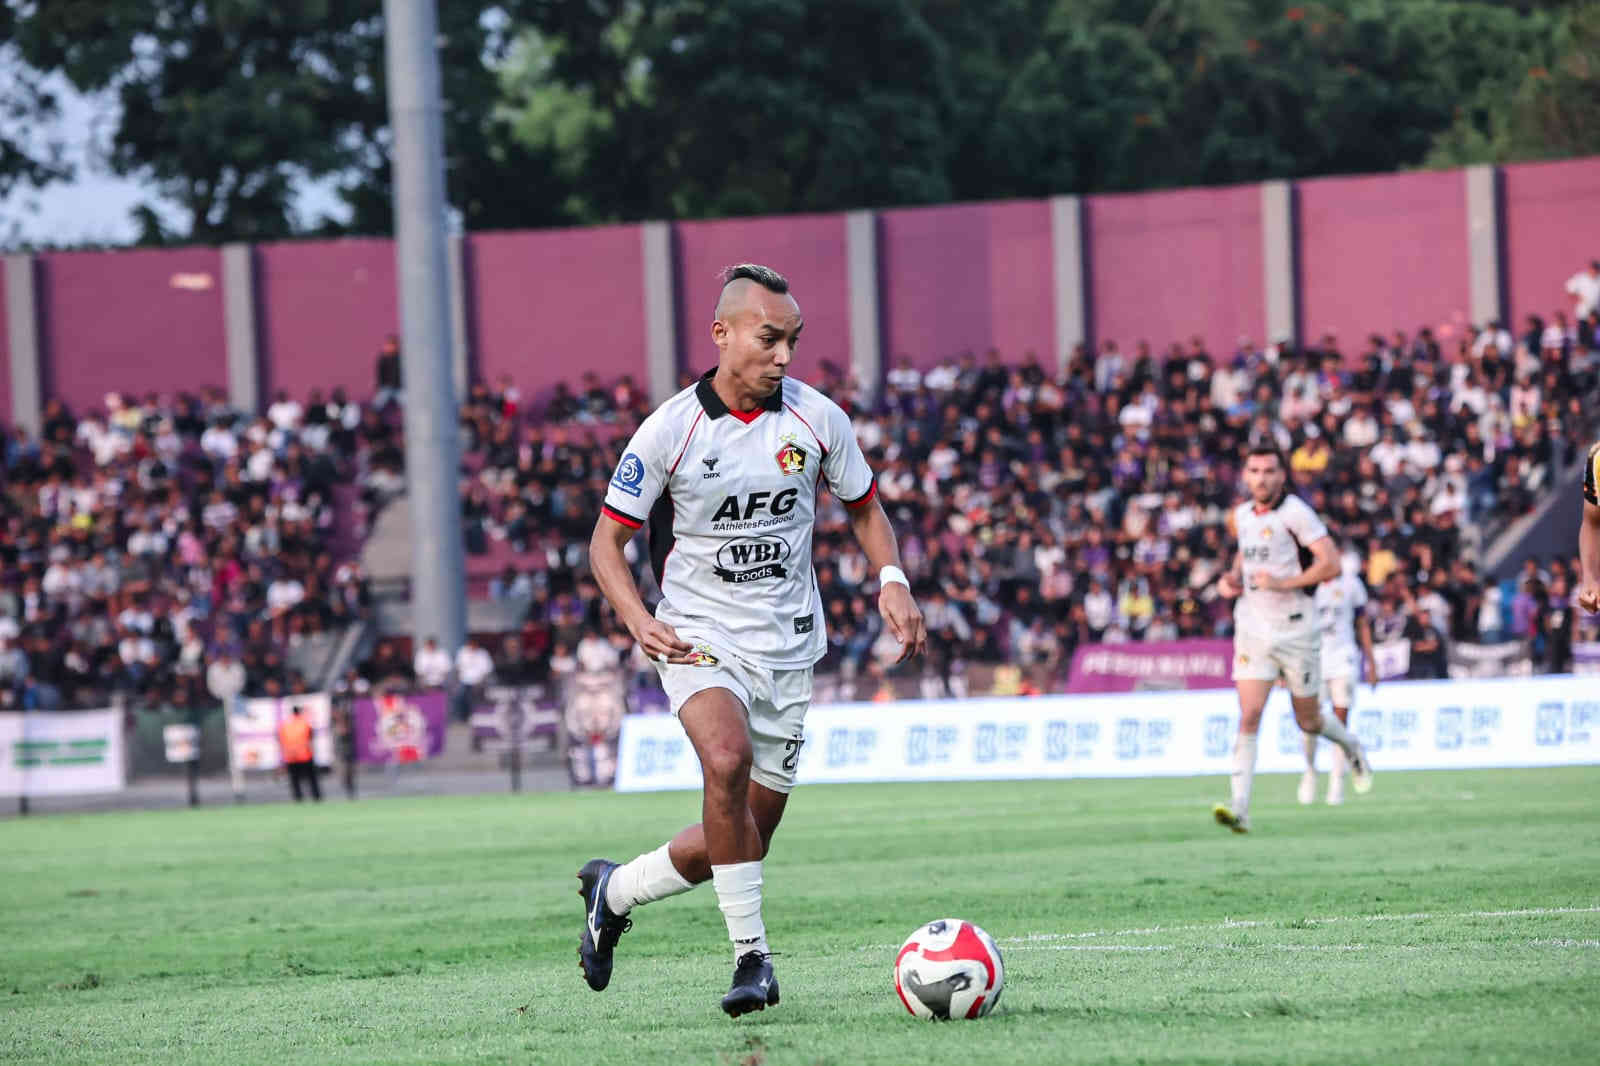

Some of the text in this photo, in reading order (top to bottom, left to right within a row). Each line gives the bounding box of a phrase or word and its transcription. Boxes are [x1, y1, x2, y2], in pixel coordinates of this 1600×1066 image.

[711, 488, 798, 521] AFG
[713, 513, 795, 531] #AthletesForGood
[729, 542, 781, 564] WBI
[734, 567, 773, 582] Foods
